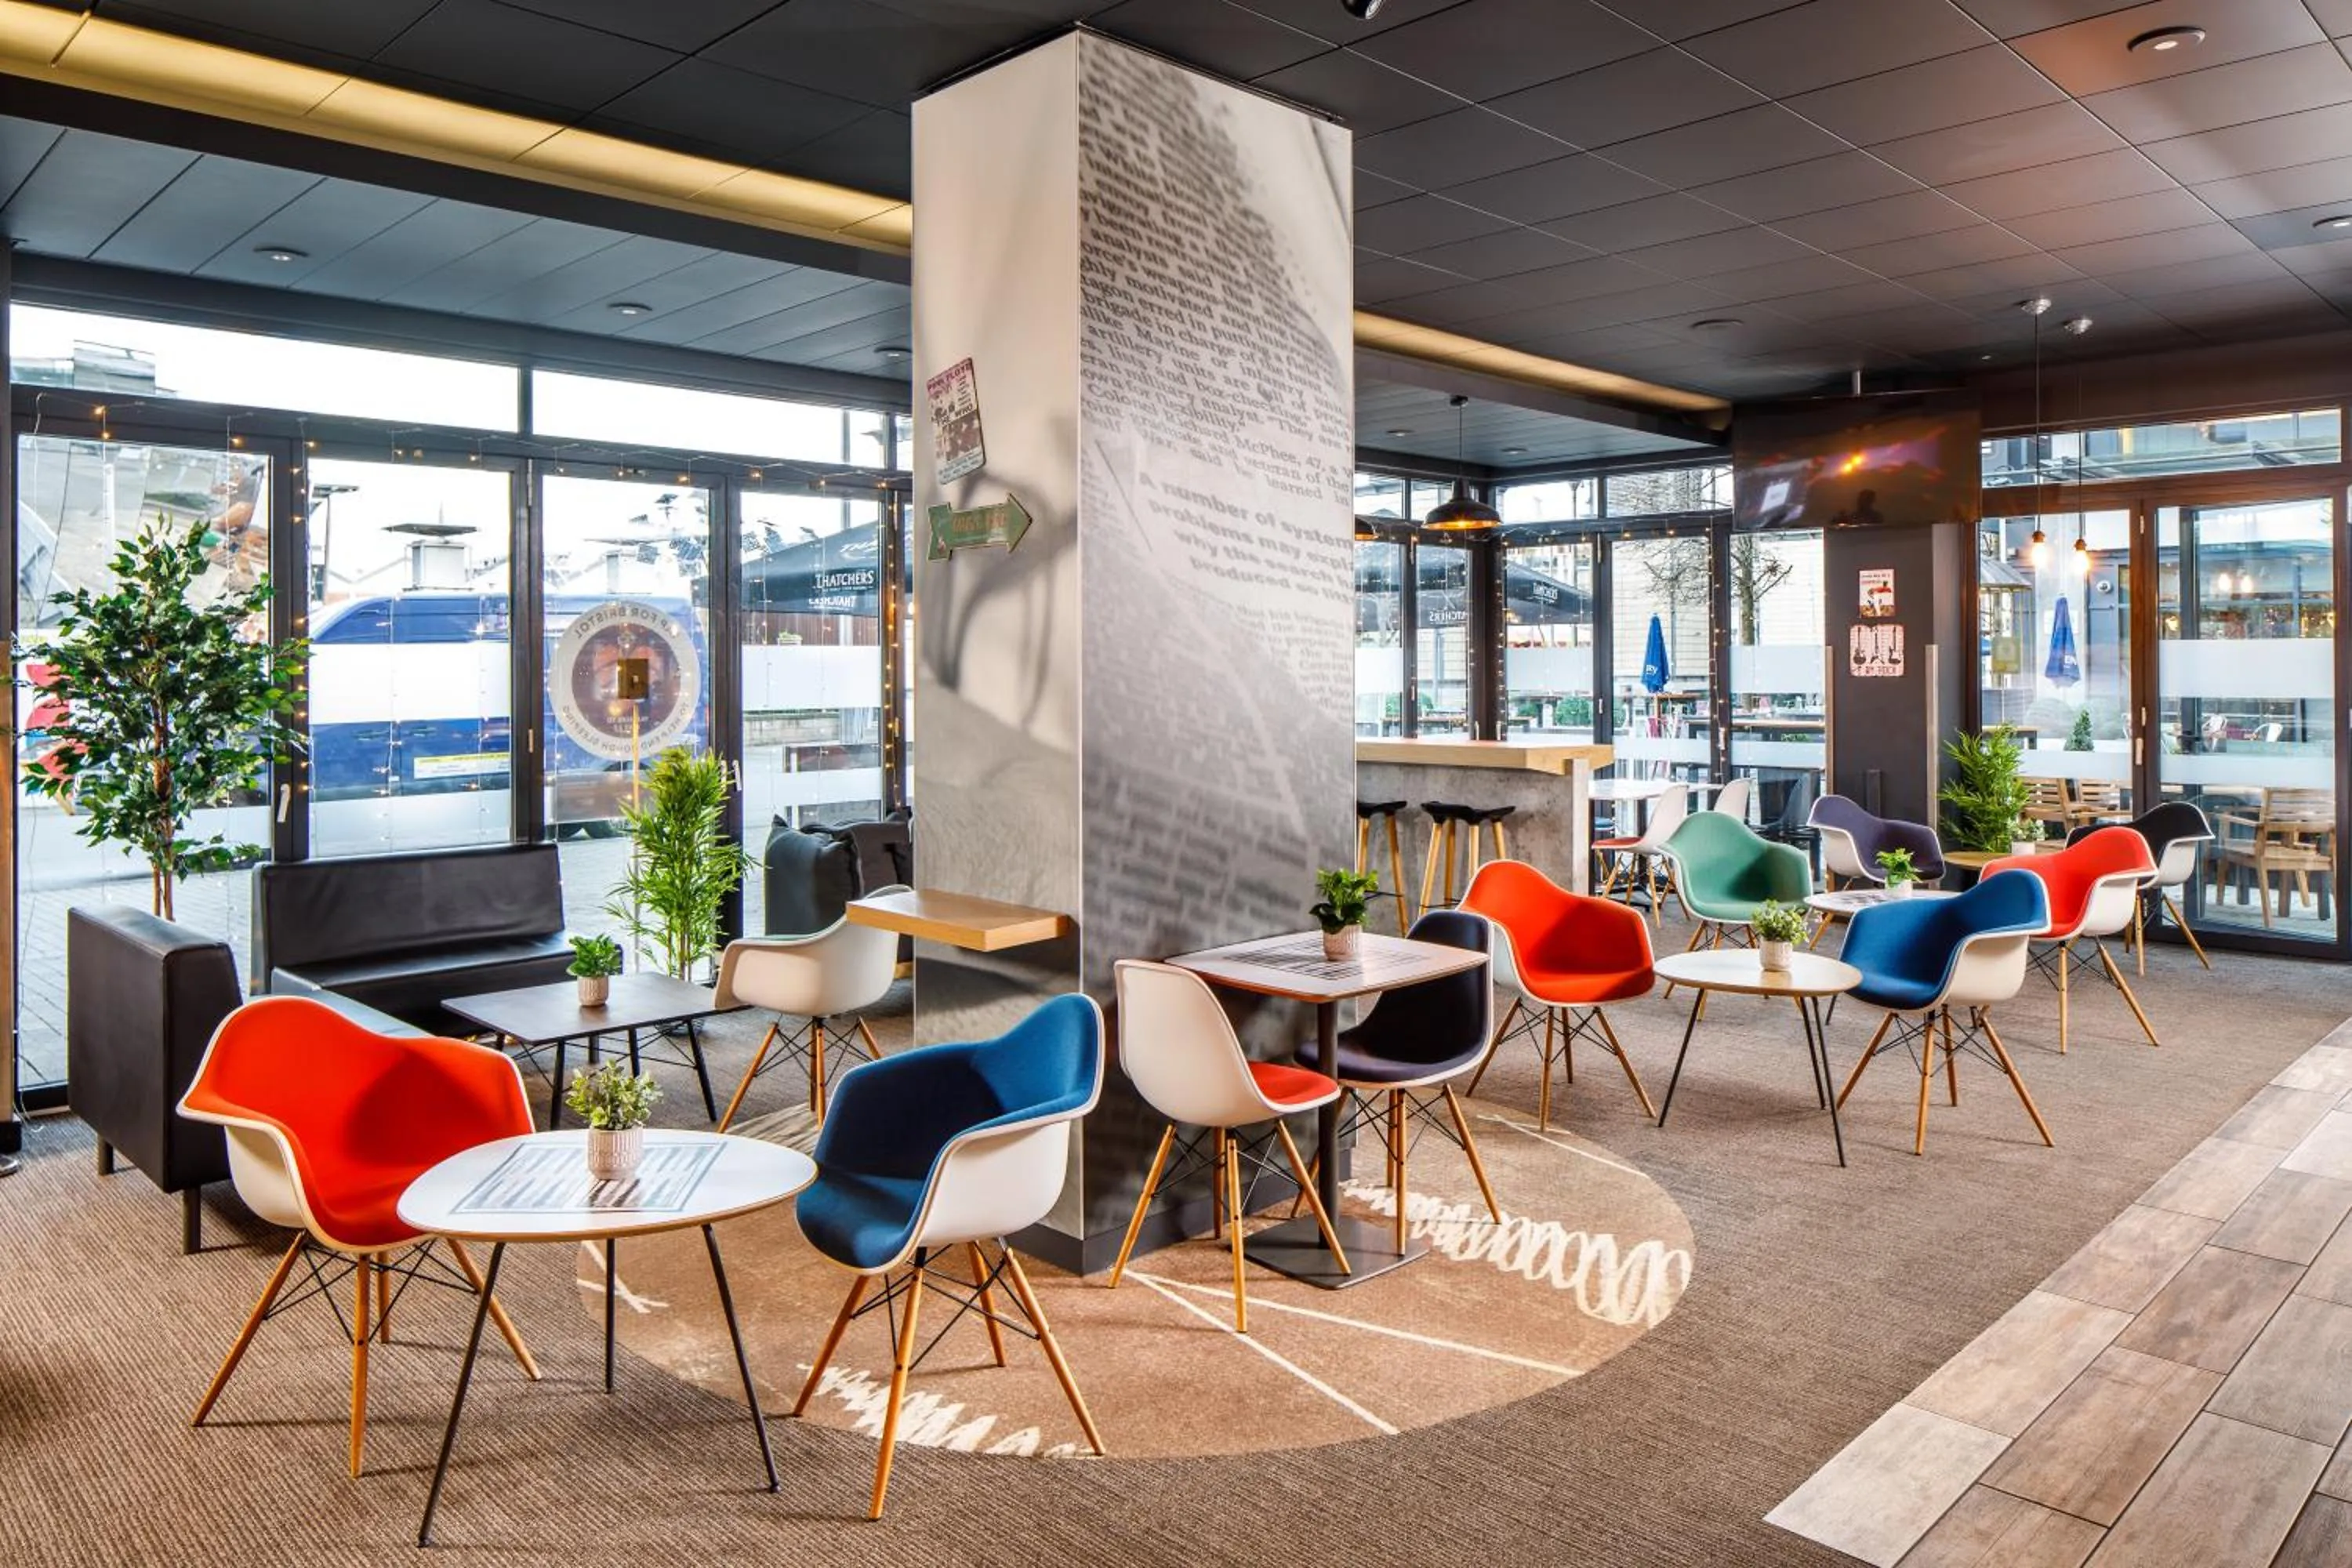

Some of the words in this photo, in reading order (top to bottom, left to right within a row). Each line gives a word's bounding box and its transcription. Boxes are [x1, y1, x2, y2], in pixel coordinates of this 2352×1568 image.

[1091, 227, 1169, 269] analysts
[1177, 265, 1214, 289] said
[1094, 207, 1143, 241] been
[1145, 235, 1254, 294] restructured
[1080, 286, 1153, 328] brigade
[1156, 317, 1176, 338] in
[1178, 328, 1236, 358] charge
[1240, 349, 1256, 363] of
[1125, 275, 1214, 319] motivated
[1221, 314, 1252, 335] and
[1138, 298, 1185, 325] erred
[1188, 312, 1208, 333] in
[1210, 325, 1272, 361] putting
[1087, 325, 1162, 364] artillery
[1172, 358, 1217, 380] units
[1223, 375, 1251, 391] are
[1108, 343, 1147, 371] lists
[1156, 365, 1188, 387] and
[1124, 367, 1196, 408] military
[1133, 322, 1200, 361] Marine
[1211, 357, 1229, 369] or
[1239, 361, 1304, 399] infantry
[1087, 383, 1159, 416] Colonel
[1163, 408, 1231, 445] Richard
[1125, 379, 1151, 399] for
[1243, 456, 1302, 481] veteran
[1305, 471, 1322, 484] of
[1266, 474, 1323, 500] learned
[1139, 472, 1158, 490] A
[1162, 481, 1250, 521] number
[1255, 511, 1276, 528] of
[1279, 519, 1353, 550] system
[1148, 499, 1254, 544] problems
[1258, 535, 1301, 560] may
[815, 570, 874, 590] THATCHERS
[1174, 528, 1218, 557] why
[1222, 546, 1261, 564] the
[1264, 557, 1334, 583] search
[1189, 555, 1291, 589] produced
